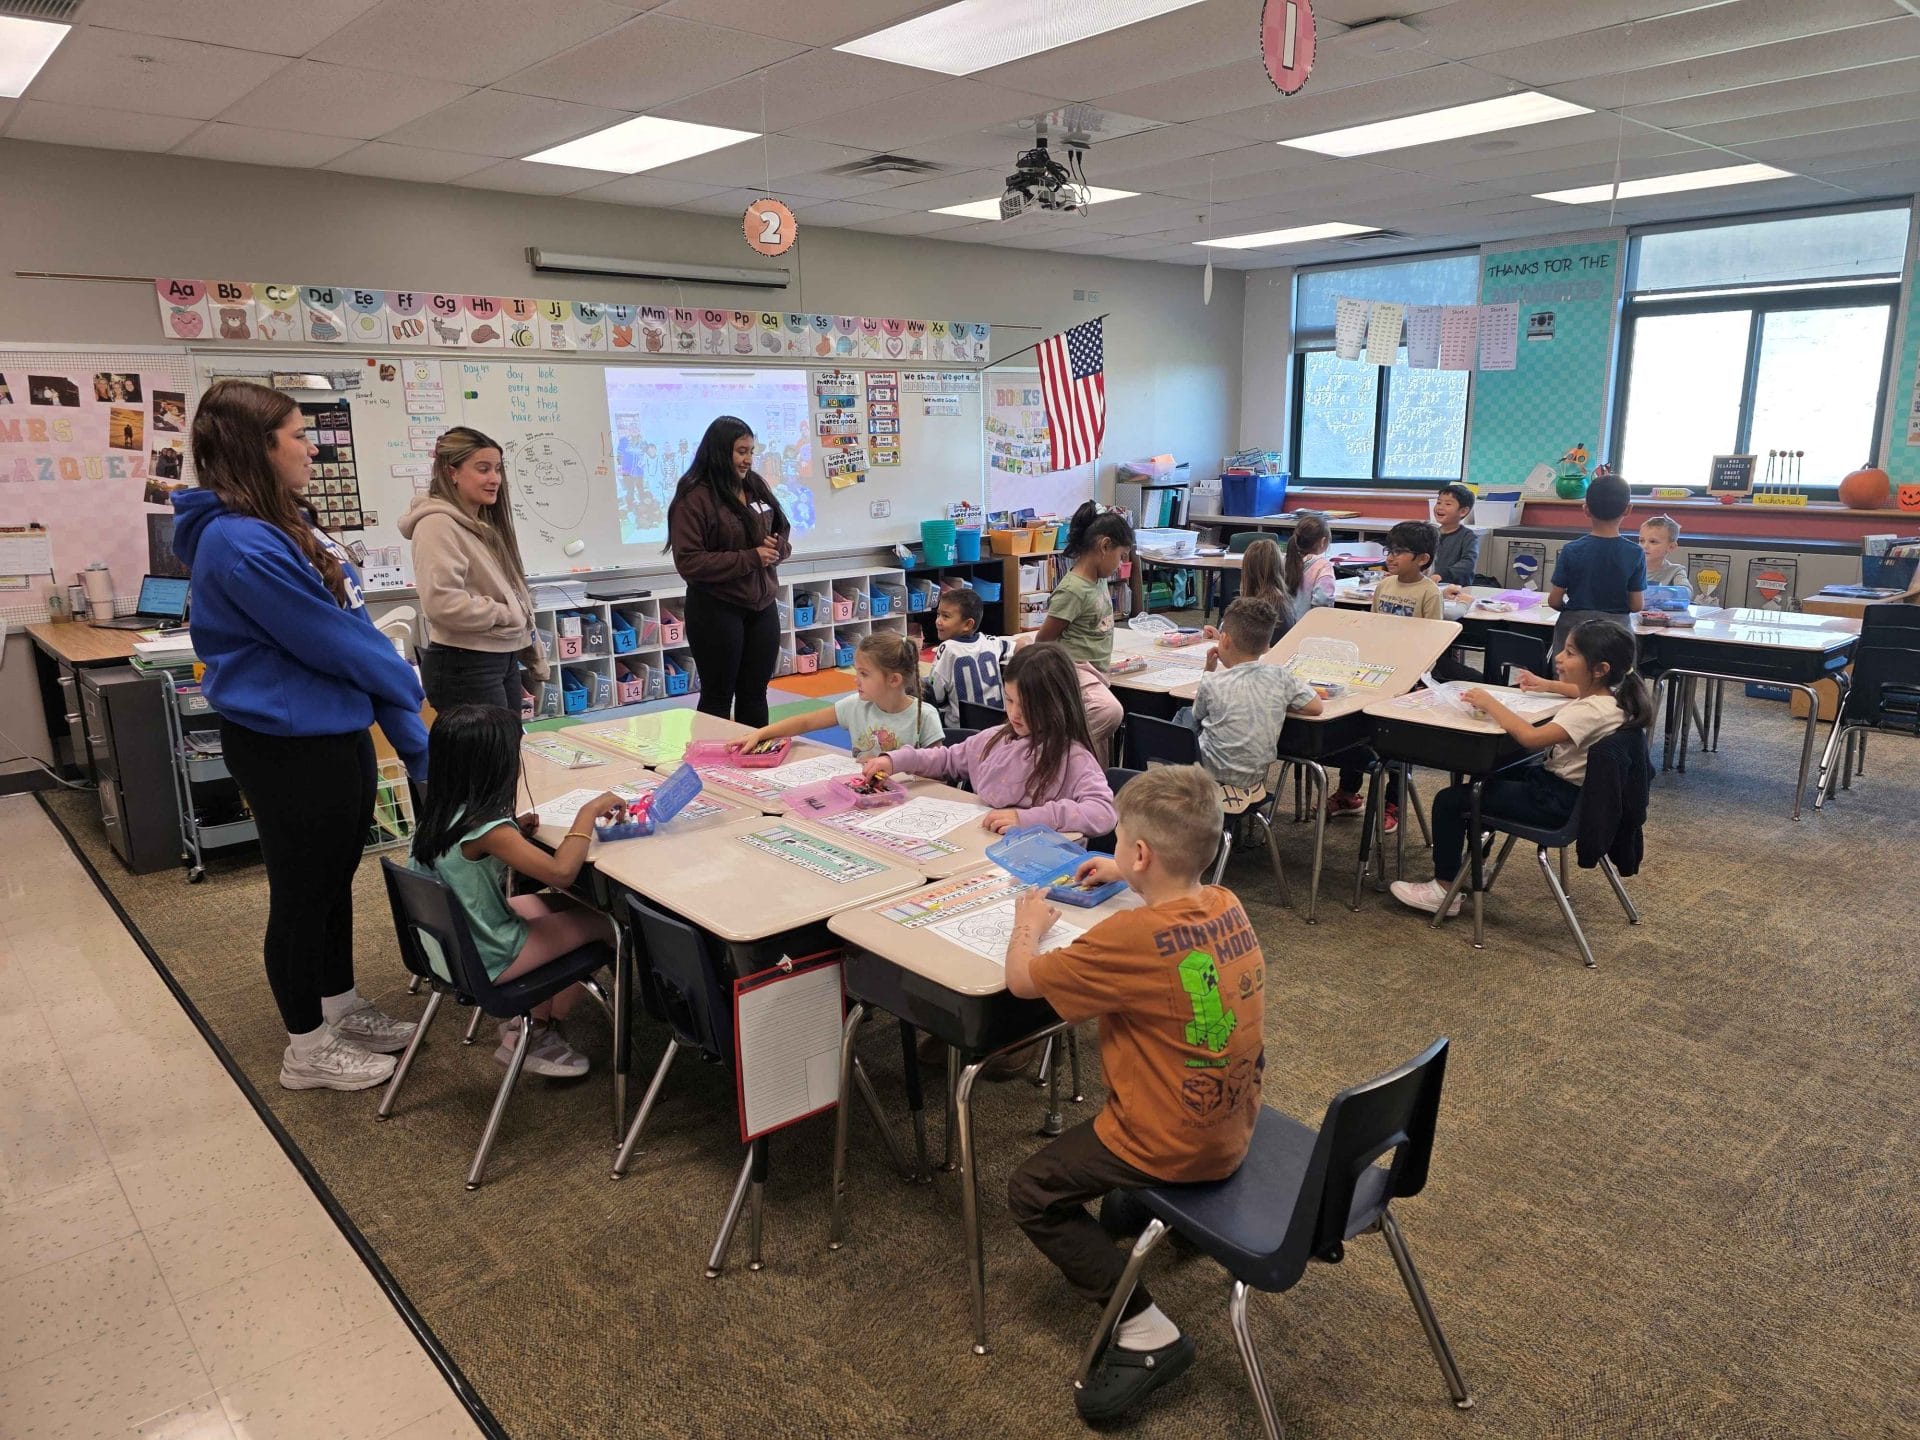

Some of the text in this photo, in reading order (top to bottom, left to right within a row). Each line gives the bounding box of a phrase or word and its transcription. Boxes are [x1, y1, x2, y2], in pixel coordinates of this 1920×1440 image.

[759, 210, 781, 244] 2
[1487, 255, 1610, 278] THANKS FOR THE
[169, 280, 194, 296] Aa
[218, 284, 242, 299] Bb
[266, 286, 288, 300] Cc
[310, 288, 334, 304] Dd
[355, 290, 374, 304] Ee
[398, 294, 412, 308] Ff
[433, 296, 456, 312] Gg
[472, 298, 493, 312] Hh
[514, 300, 526, 314] Ii
[549, 302, 562, 318] Jj
[580, 304, 598, 317] Kk
[641, 307, 665, 320] Mm
[676, 309, 692, 321] Nn
[705, 310, 722, 322] Oo
[734, 312, 750, 326] Pp
[790, 314, 802, 326] Rr
[762, 313, 778, 328] Qq
[816, 316, 828, 327] Ss
[864, 318, 876, 330] Uu
[887, 320, 900, 330] Vv
[908, 321, 924, 332] Ww
[932, 322, 944, 333] Xx
[954, 323, 965, 336] Yy
[975, 325, 986, 336] Zz
[506, 366, 523, 381] day
[508, 384, 529, 396] every
[537, 384, 558, 394] made
[996, 389, 1040, 406] BOOKS
[538, 397, 558, 413] they
[512, 411, 532, 422] have
[847, 456, 864, 464] good
[893, 596, 902, 607] 10
[842, 607, 848, 616] 9
[877, 604, 888, 613] 10
[802, 612, 809, 622] 8
[670, 629, 679, 640] 5
[567, 642, 577, 654] 3
[622, 636, 631, 647] 4
[652, 678, 660, 691] 14
[954, 651, 1004, 710] 09
[600, 684, 610, 698] 13
[626, 687, 641, 697] 14
[548, 693, 558, 707] 12
